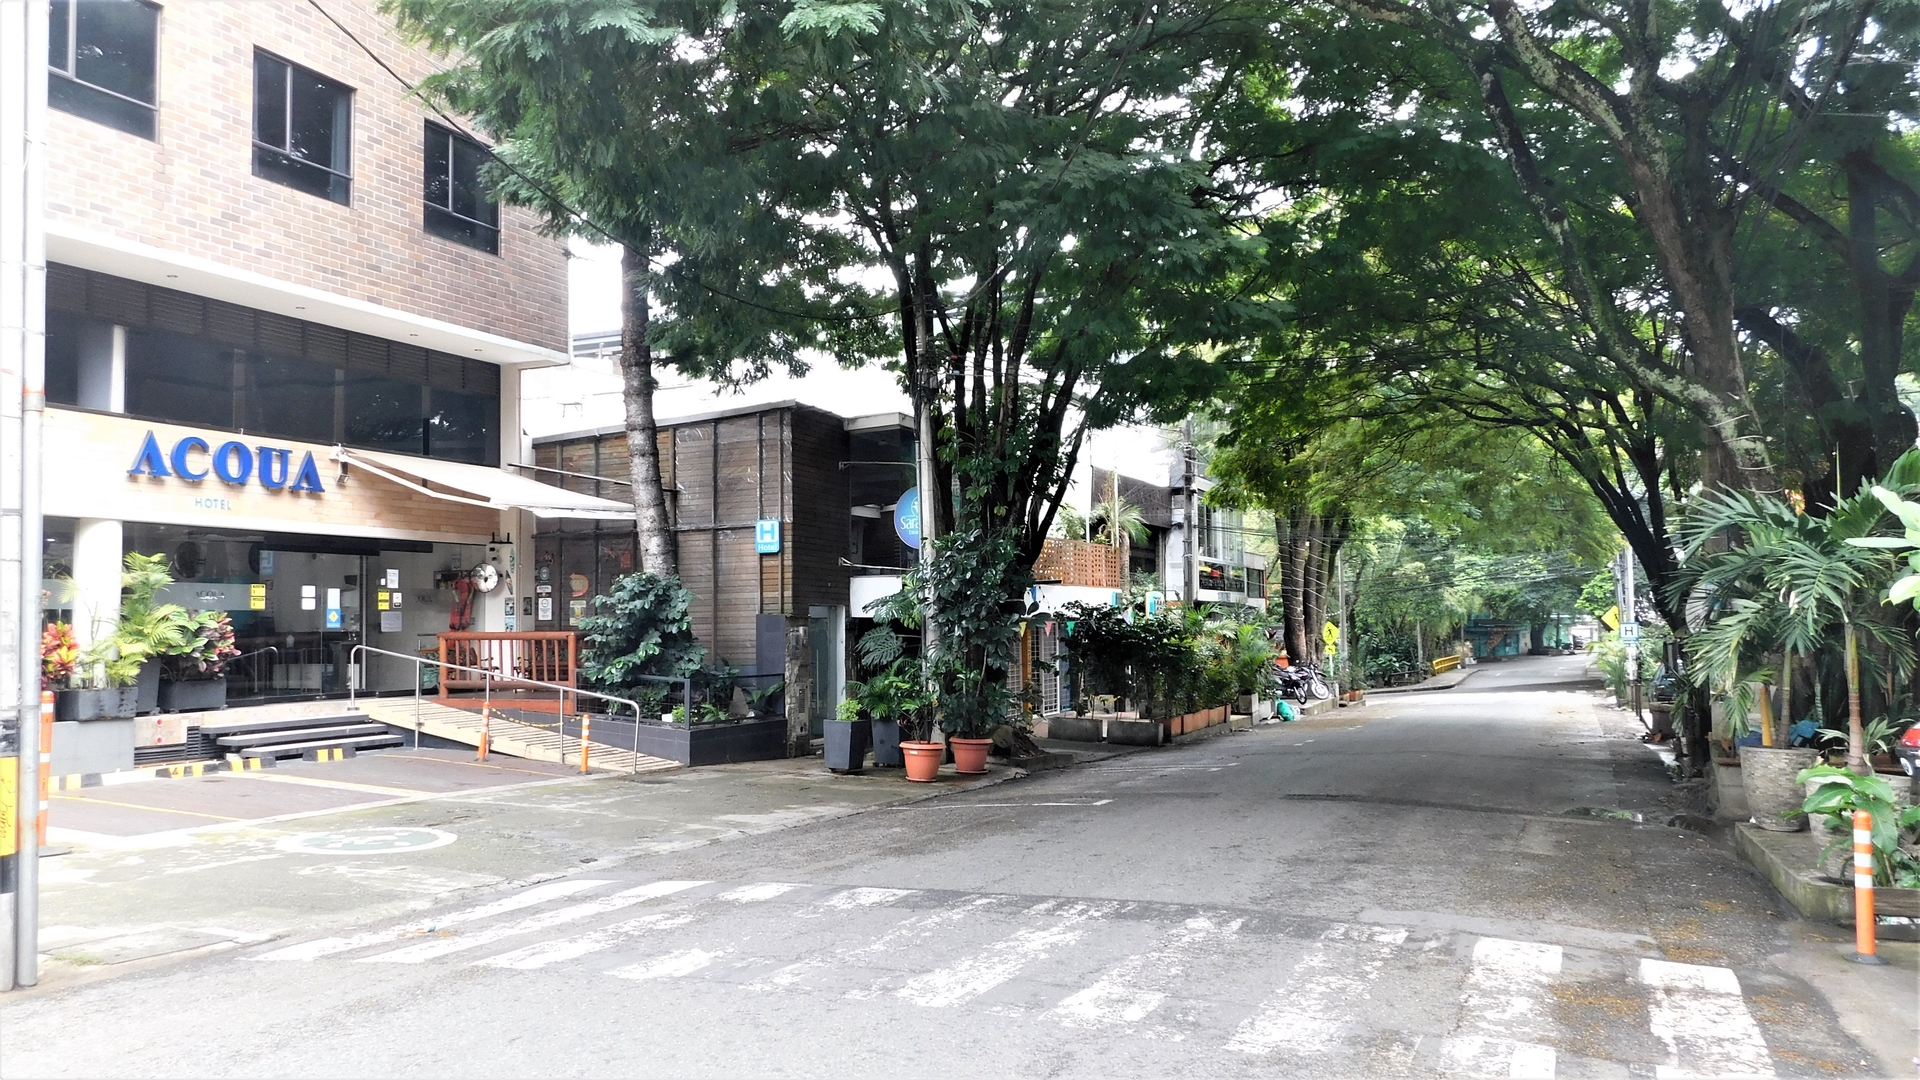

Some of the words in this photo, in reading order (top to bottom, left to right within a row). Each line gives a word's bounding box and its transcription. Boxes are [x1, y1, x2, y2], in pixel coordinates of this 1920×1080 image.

[127, 430, 325, 493] ACQUA
[195, 497, 232, 510] HOTEL
[760, 523, 775, 541] H
[1625, 626, 1633, 635] H
